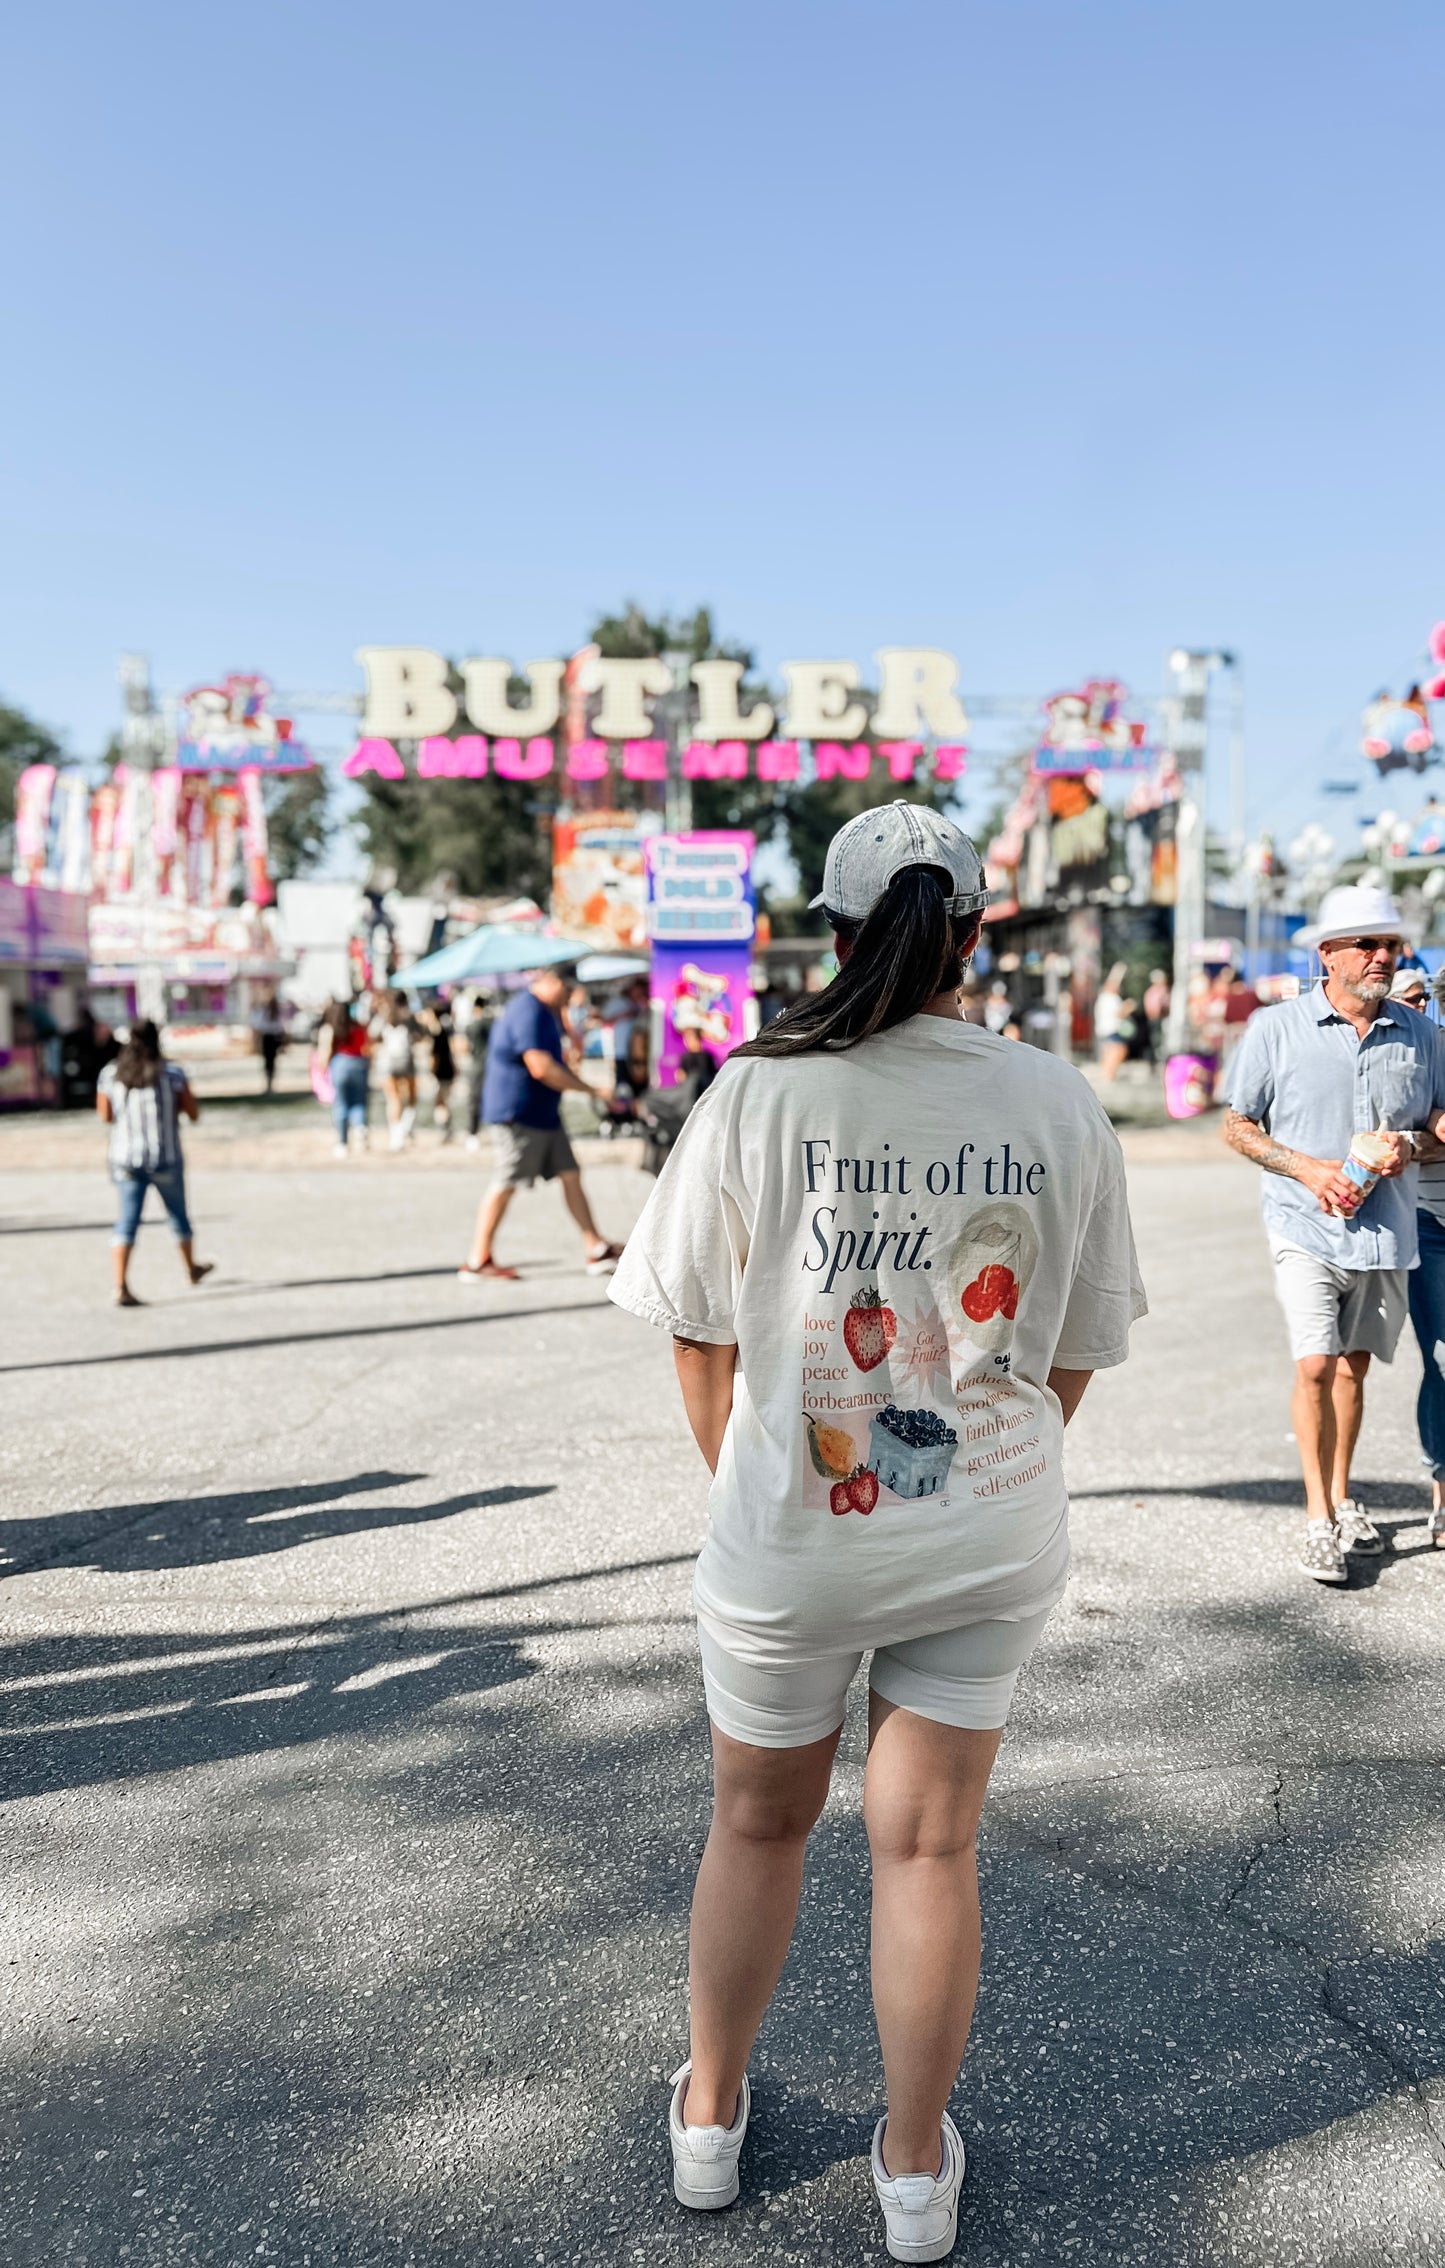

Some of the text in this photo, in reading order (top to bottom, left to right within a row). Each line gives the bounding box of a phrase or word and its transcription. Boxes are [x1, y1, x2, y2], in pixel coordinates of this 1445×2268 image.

[358, 646, 969, 740] BUTLER
[342, 735, 968, 781] AMUSEMENTS
[801, 1139, 1046, 1196] Fruit of the
[801, 1206, 933, 1294] Spirit.
[804, 1312, 836, 1332] love
[803, 1335, 829, 1360] joy
[909, 1344, 948, 1365] Fruit?
[802, 1363, 849, 1386] peace
[802, 1391, 893, 1410] forbearance
[957, 1389, 1018, 1420] goodness
[965, 1406, 1035, 1442] faithfulness
[967, 1434, 1040, 1477] gentleness
[972, 1454, 1047, 1500] self-control
